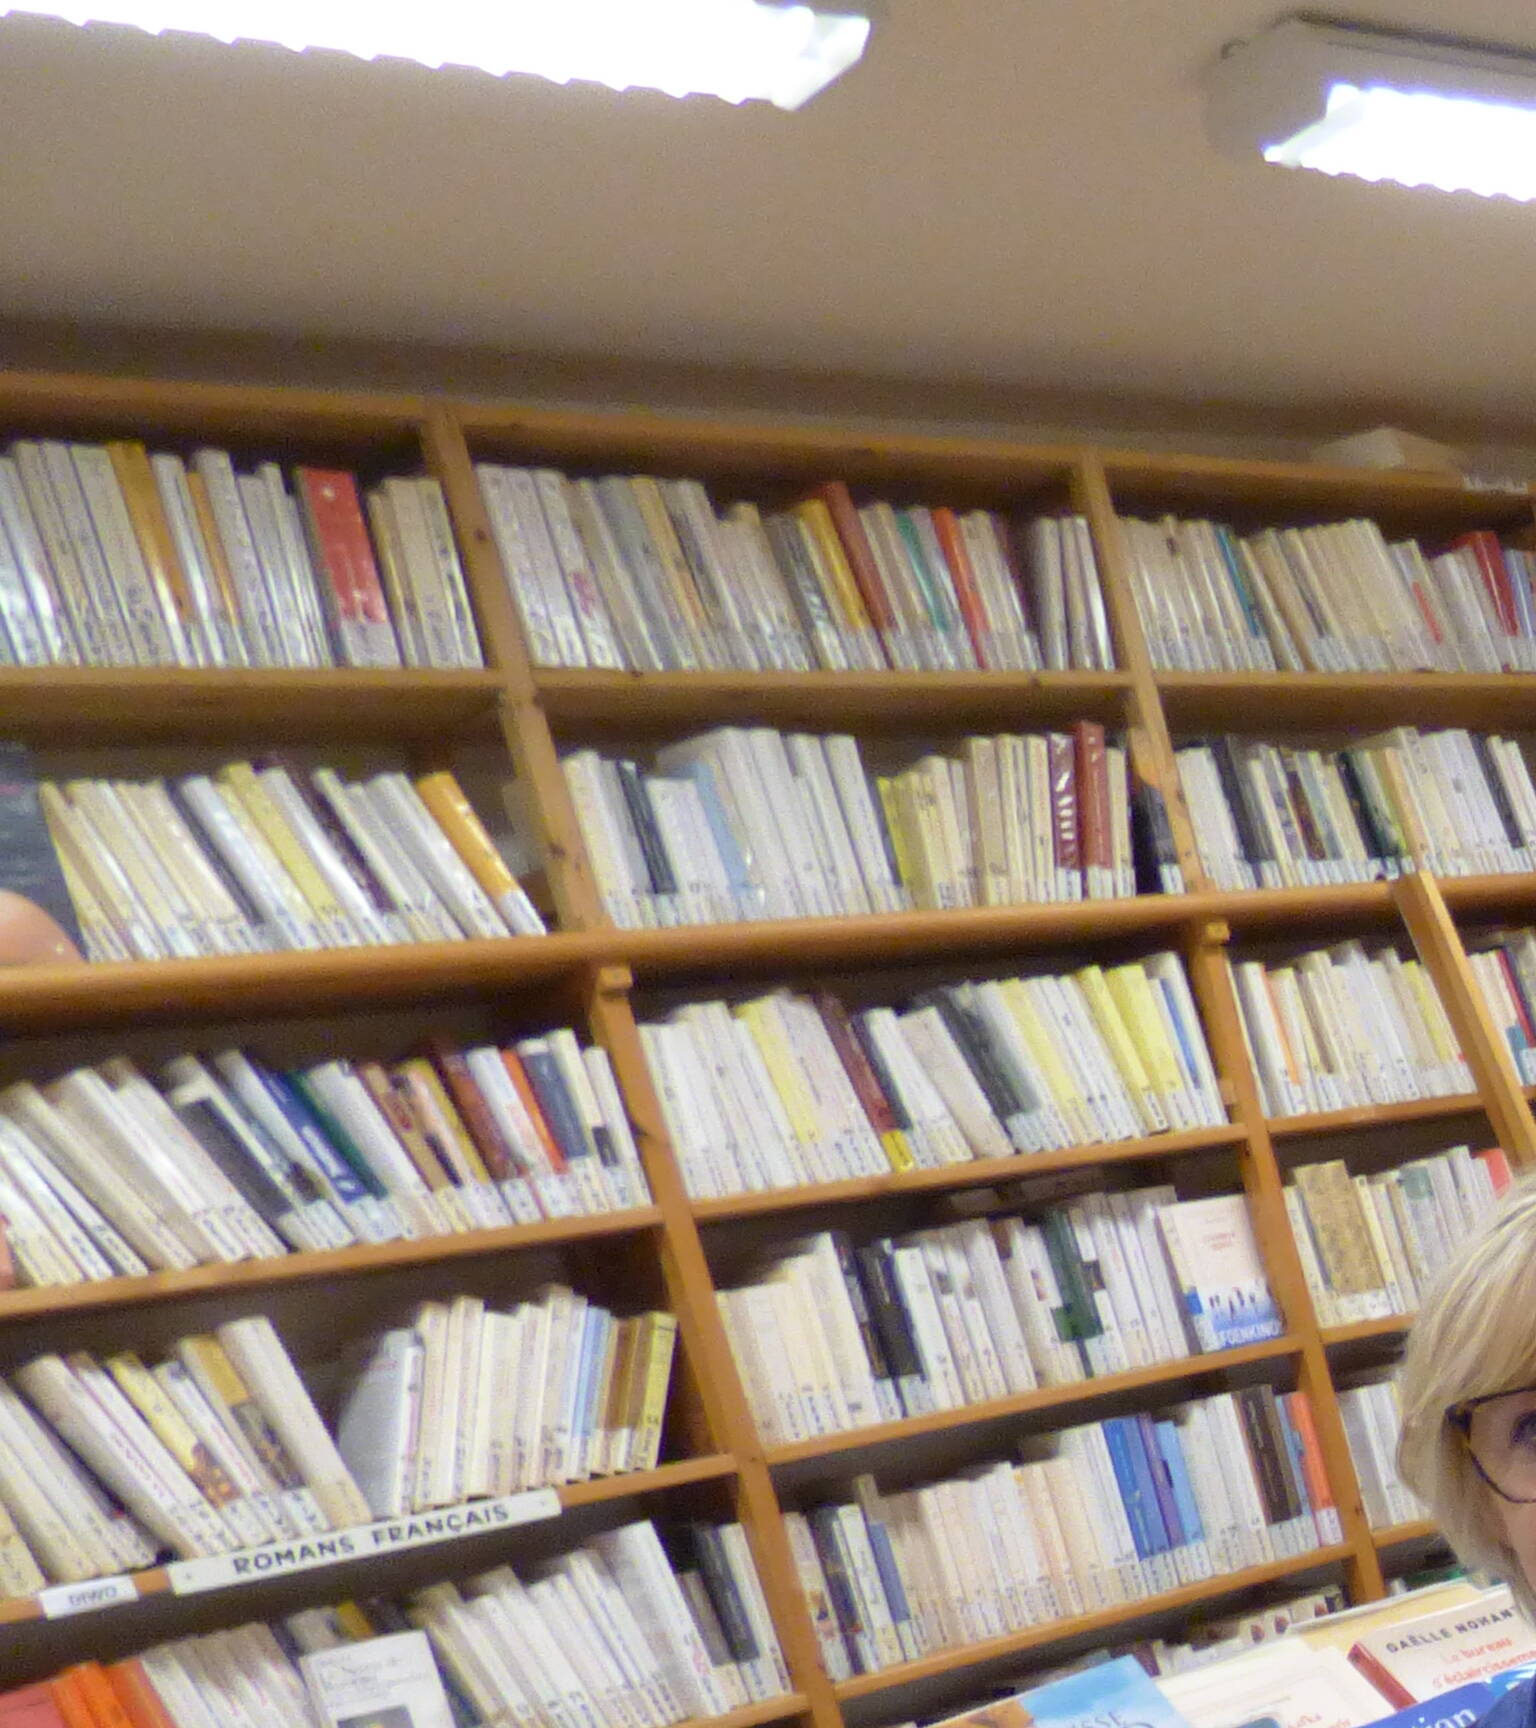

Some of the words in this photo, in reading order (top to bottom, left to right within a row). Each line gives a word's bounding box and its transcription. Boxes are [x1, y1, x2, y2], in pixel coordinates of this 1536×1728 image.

[232, 1535, 356, 1578] ROMANS
[370, 1502, 510, 1550] FRANÇAIS
[1385, 1627, 1454, 1655] GAËLLE
